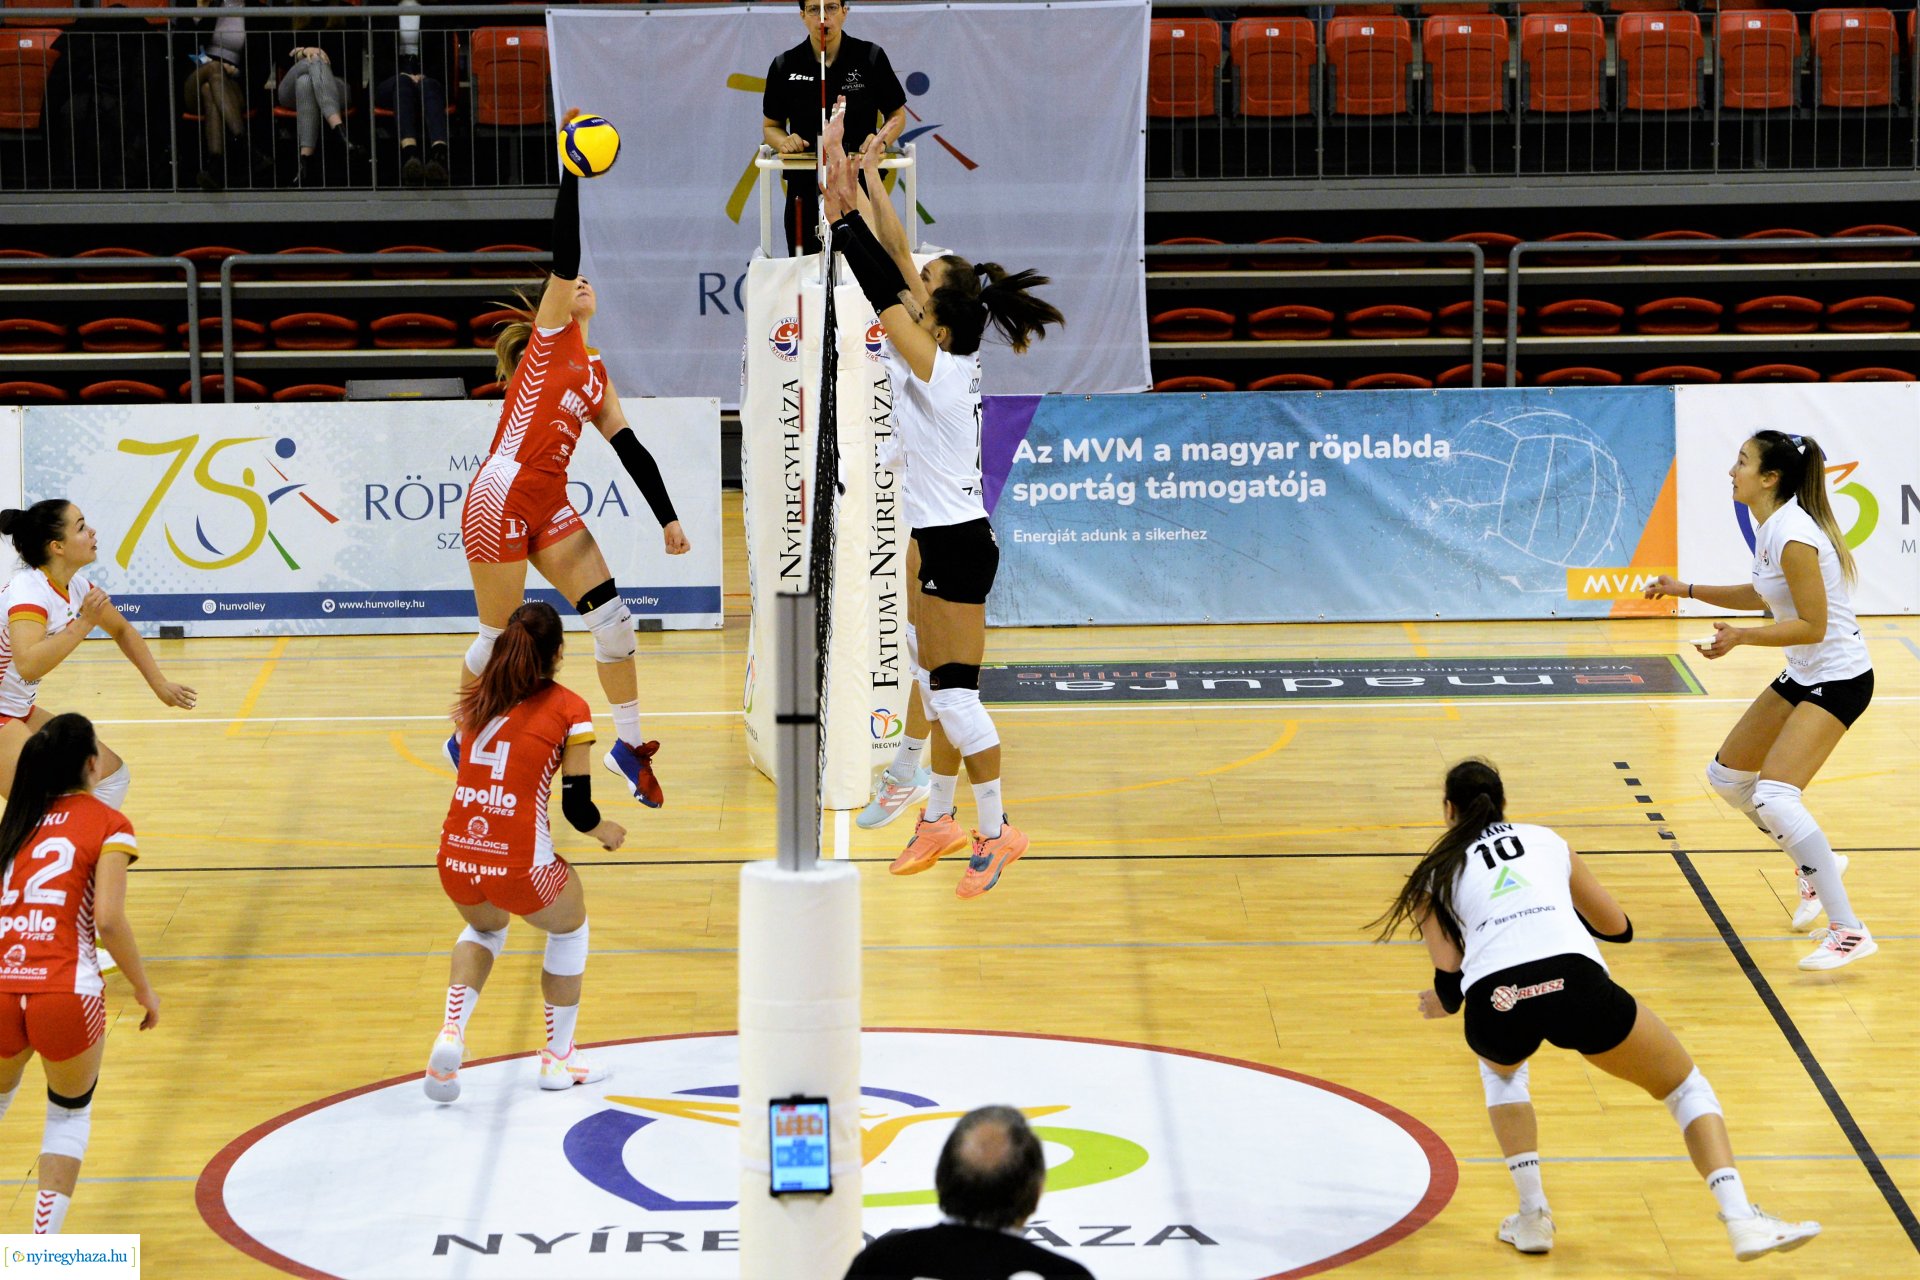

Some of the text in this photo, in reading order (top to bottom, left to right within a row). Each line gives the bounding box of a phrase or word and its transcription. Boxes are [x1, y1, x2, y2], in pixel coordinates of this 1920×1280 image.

[1012, 433, 1451, 466] Az MVM a magyar röplabda
[365, 474, 629, 521] RÖPDA
[1012, 471, 1327, 507] sportág támogatója
[1013, 528, 1208, 546] Energiát adunk a sikerhez
[219, 600, 266, 613] hunvolley
[338, 598, 426, 610] www.hunvolley.hu
[620, 595, 659, 607] unvolley
[469, 716, 511, 781] 4
[455, 784, 517, 808] apollo
[482, 805, 516, 817] TYRES
[448, 833, 510, 851] SZABADICS
[1473, 835, 1525, 870] 10
[0, 909, 57, 939] pollo
[20, 932, 55, 941] TYRES
[431, 1221, 1220, 1256] NYÍREÁZA
